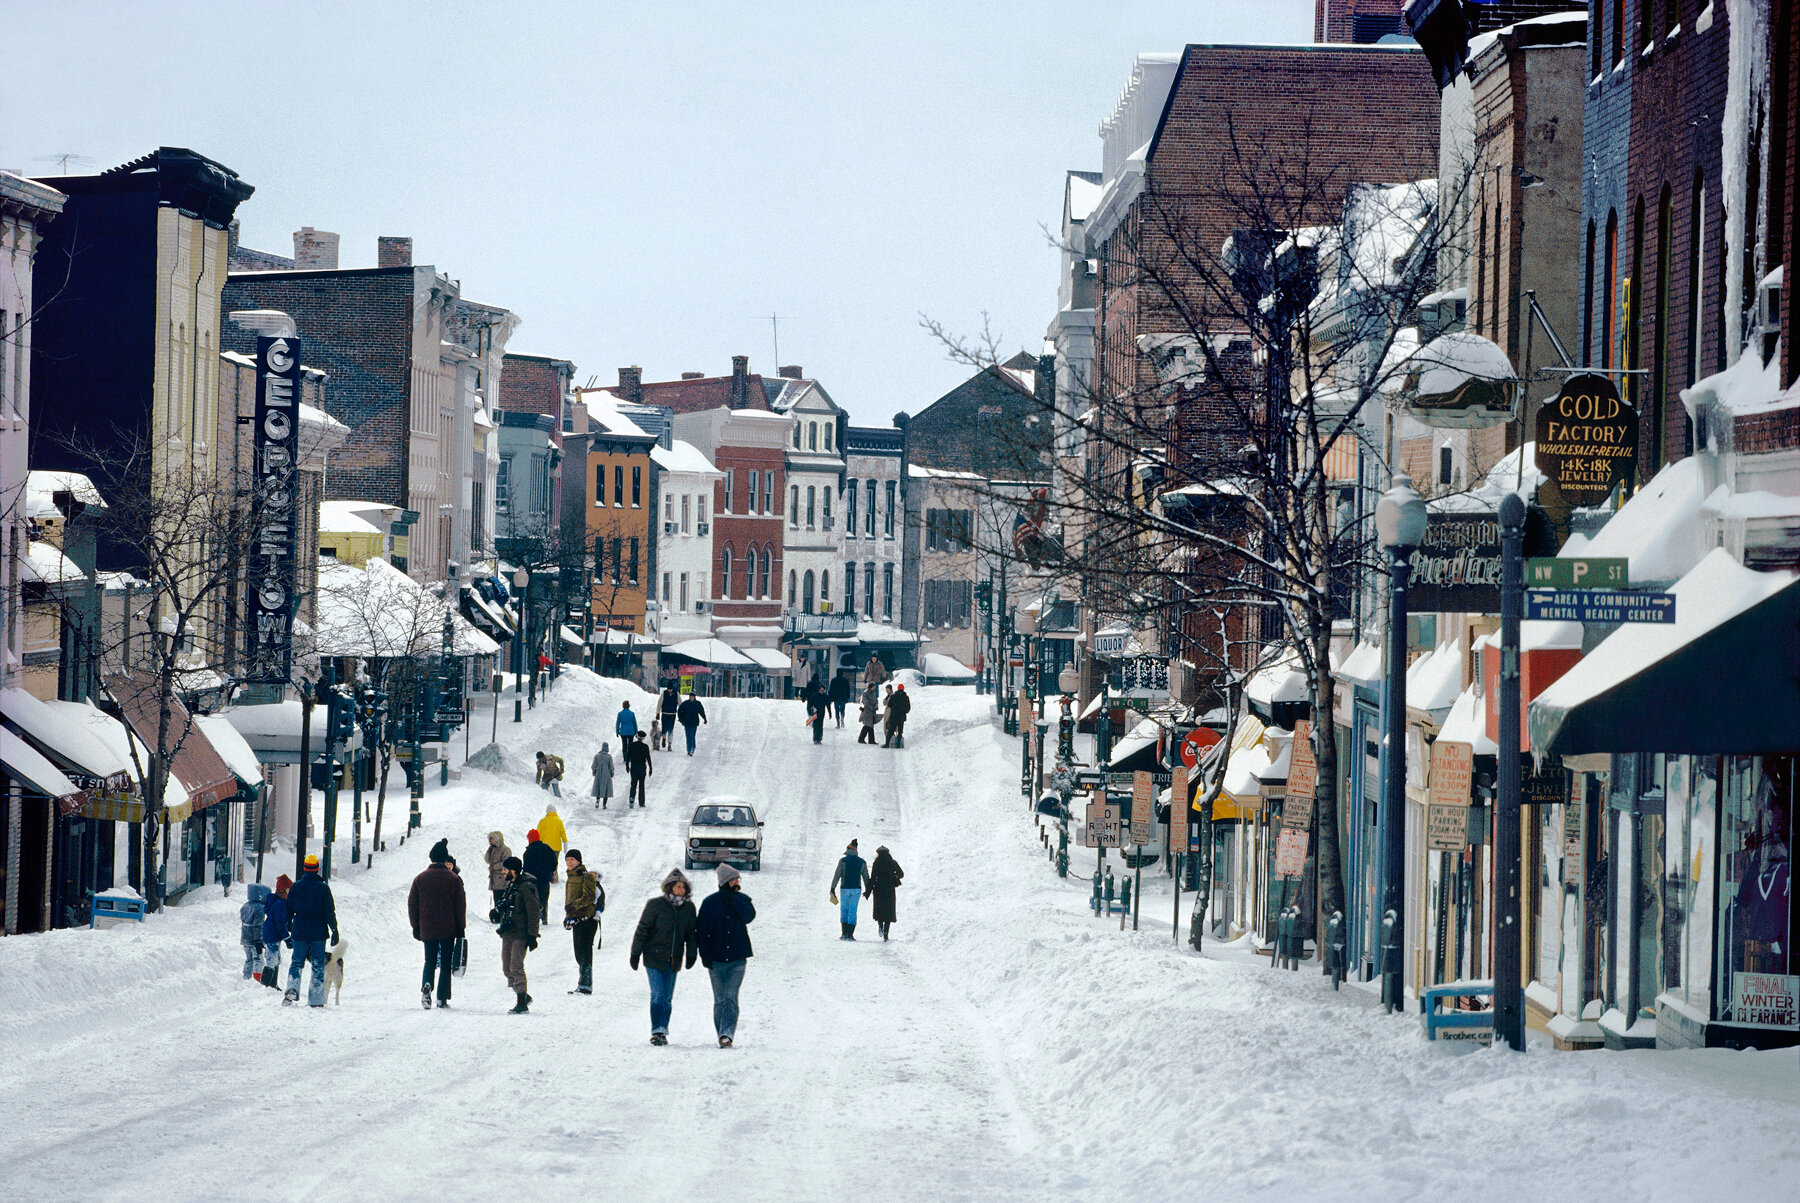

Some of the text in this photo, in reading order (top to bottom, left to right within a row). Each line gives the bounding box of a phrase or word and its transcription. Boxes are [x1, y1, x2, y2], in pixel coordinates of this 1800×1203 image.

[1559, 394, 1619, 420] GOLD
[1548, 421, 1627, 443] FACTORY
[1560, 458, 1612, 471] 14K-18K
[1558, 471, 1612, 482] JEWELRY
[254, 338, 294, 678] GEORGETOWN
[1535, 562, 1621, 584] NW P ST
[1554, 594, 1650, 607] AREA A COMMUNITY
[1540, 607, 1663, 621] MENTAL HEALTH CENTER
[1096, 638, 1123, 652] LIQUOR
[1445, 746, 1460, 758] NO
[1432, 758, 1469, 771] STANDING
[1152, 773, 1172, 783] ERIE
[1432, 807, 1465, 818] ONE HOUR
[1089, 822, 1118, 833] RHT
[1434, 816, 1462, 826] PARKING
[1741, 994, 1794, 1009] WINTER
[1737, 1008, 1797, 1026] CLEARANCE
[1442, 1031, 1493, 1041] Brother, can
